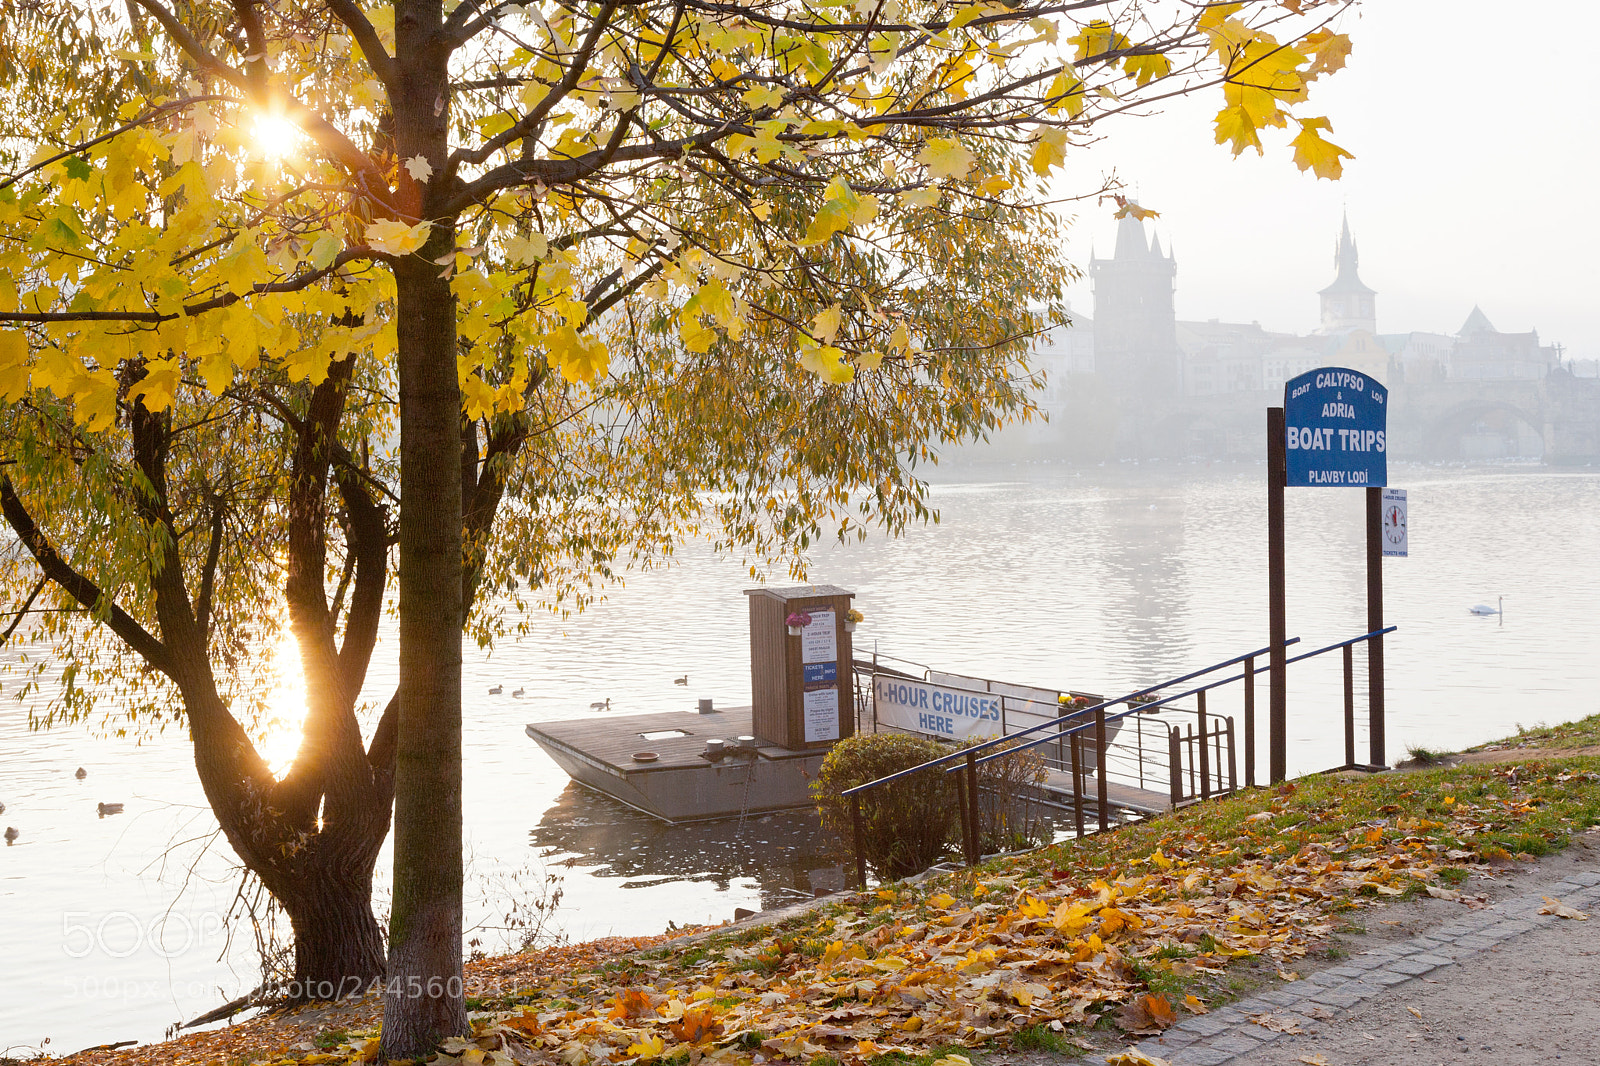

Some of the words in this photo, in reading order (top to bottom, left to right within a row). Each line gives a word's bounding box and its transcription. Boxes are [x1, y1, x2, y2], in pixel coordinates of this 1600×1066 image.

[1292, 382, 1311, 399] BOAT
[1316, 372, 1364, 392] CALYPSO
[1337, 391, 1342, 400] &
[1321, 402, 1356, 419] ADRIA
[1287, 426, 1334, 451] BOAT
[1338, 428, 1386, 453] TRIPS
[1308, 470, 1345, 483] PLAVBY
[1347, 468, 1369, 484] LODÍ
[876, 681, 929, 709] 1-HOUR
[932, 691, 1000, 721] CRUISES
[919, 712, 954, 735] HERE
